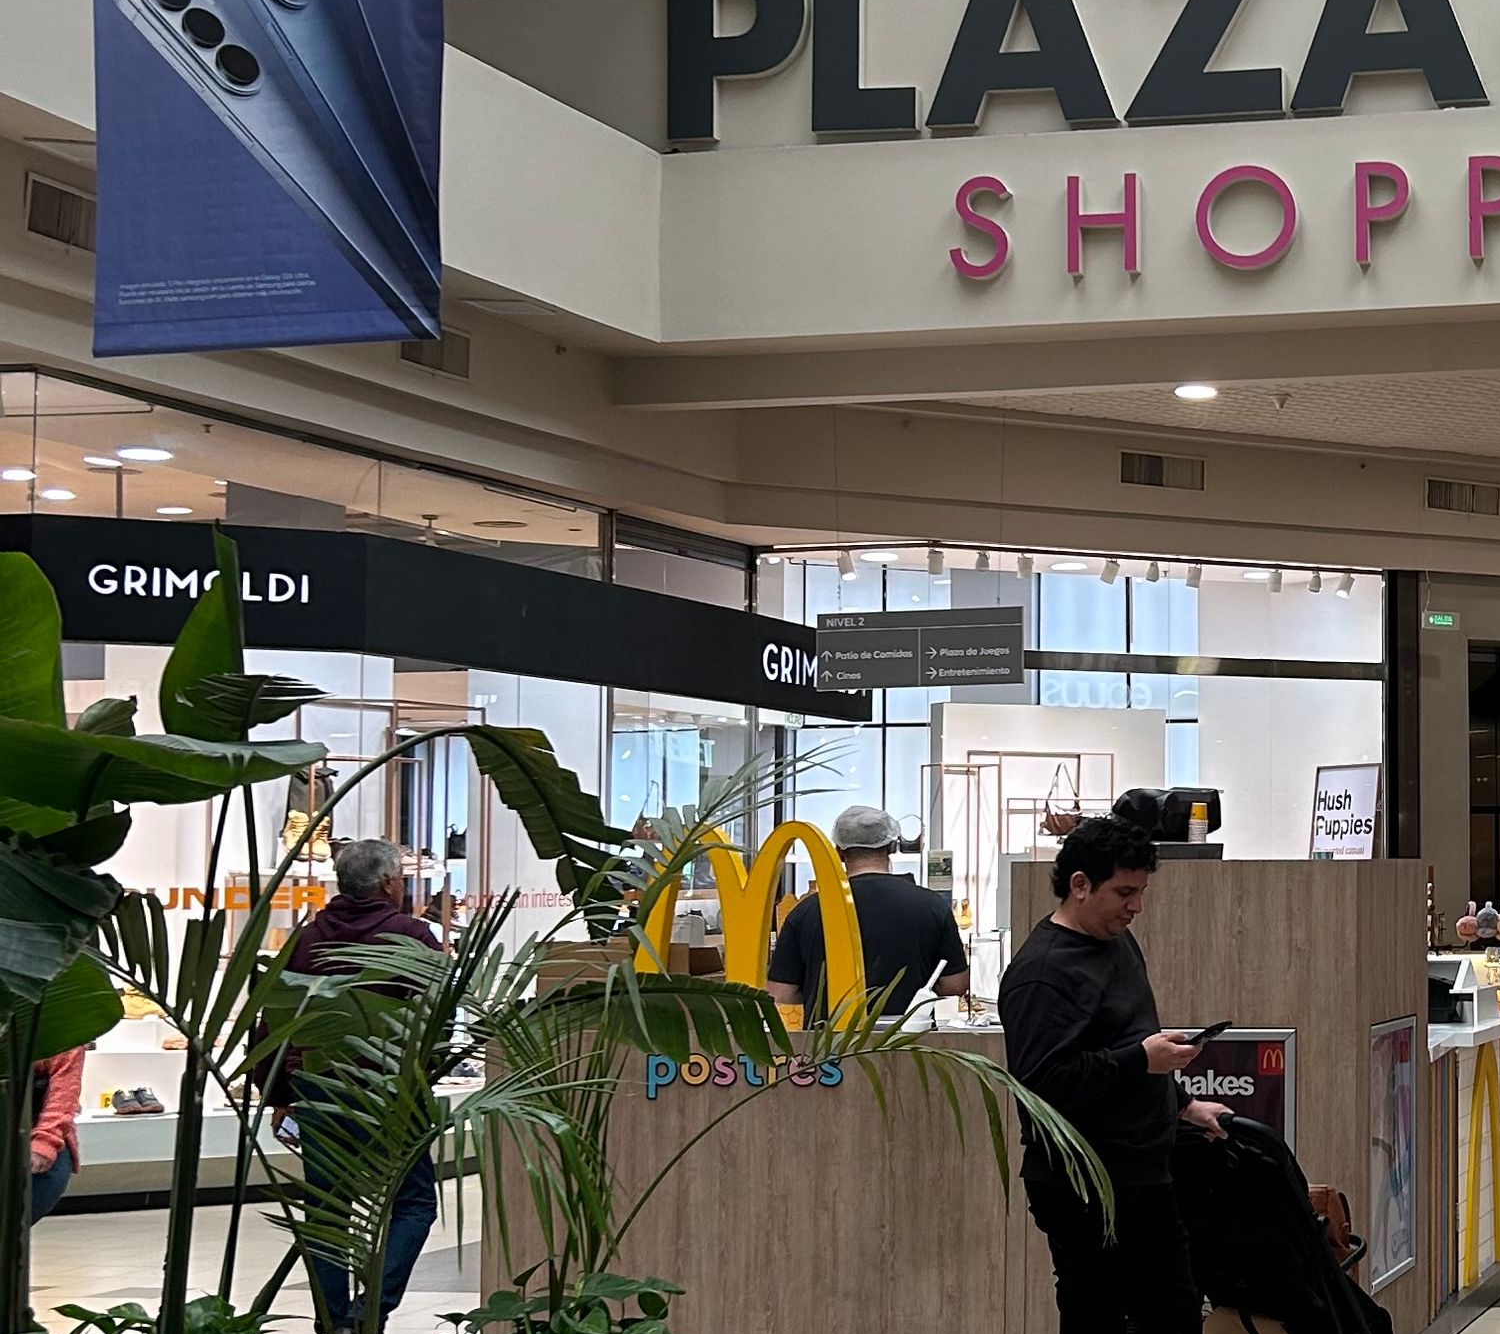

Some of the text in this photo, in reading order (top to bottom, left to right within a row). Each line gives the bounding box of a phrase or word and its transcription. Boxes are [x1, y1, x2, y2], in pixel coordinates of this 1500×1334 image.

[825, 617, 865, 628] NIVEL 2
[835, 649, 913, 661] Patio de Comidas
[978, 645, 1010, 658] Juegos
[938, 666, 1010, 677] Entretenimiento
[1317, 789, 1352, 811] Hush
[1315, 814, 1373, 841] Puppies
[646, 1053, 844, 1100] postres
[1174, 1069, 1255, 1096] hakes
